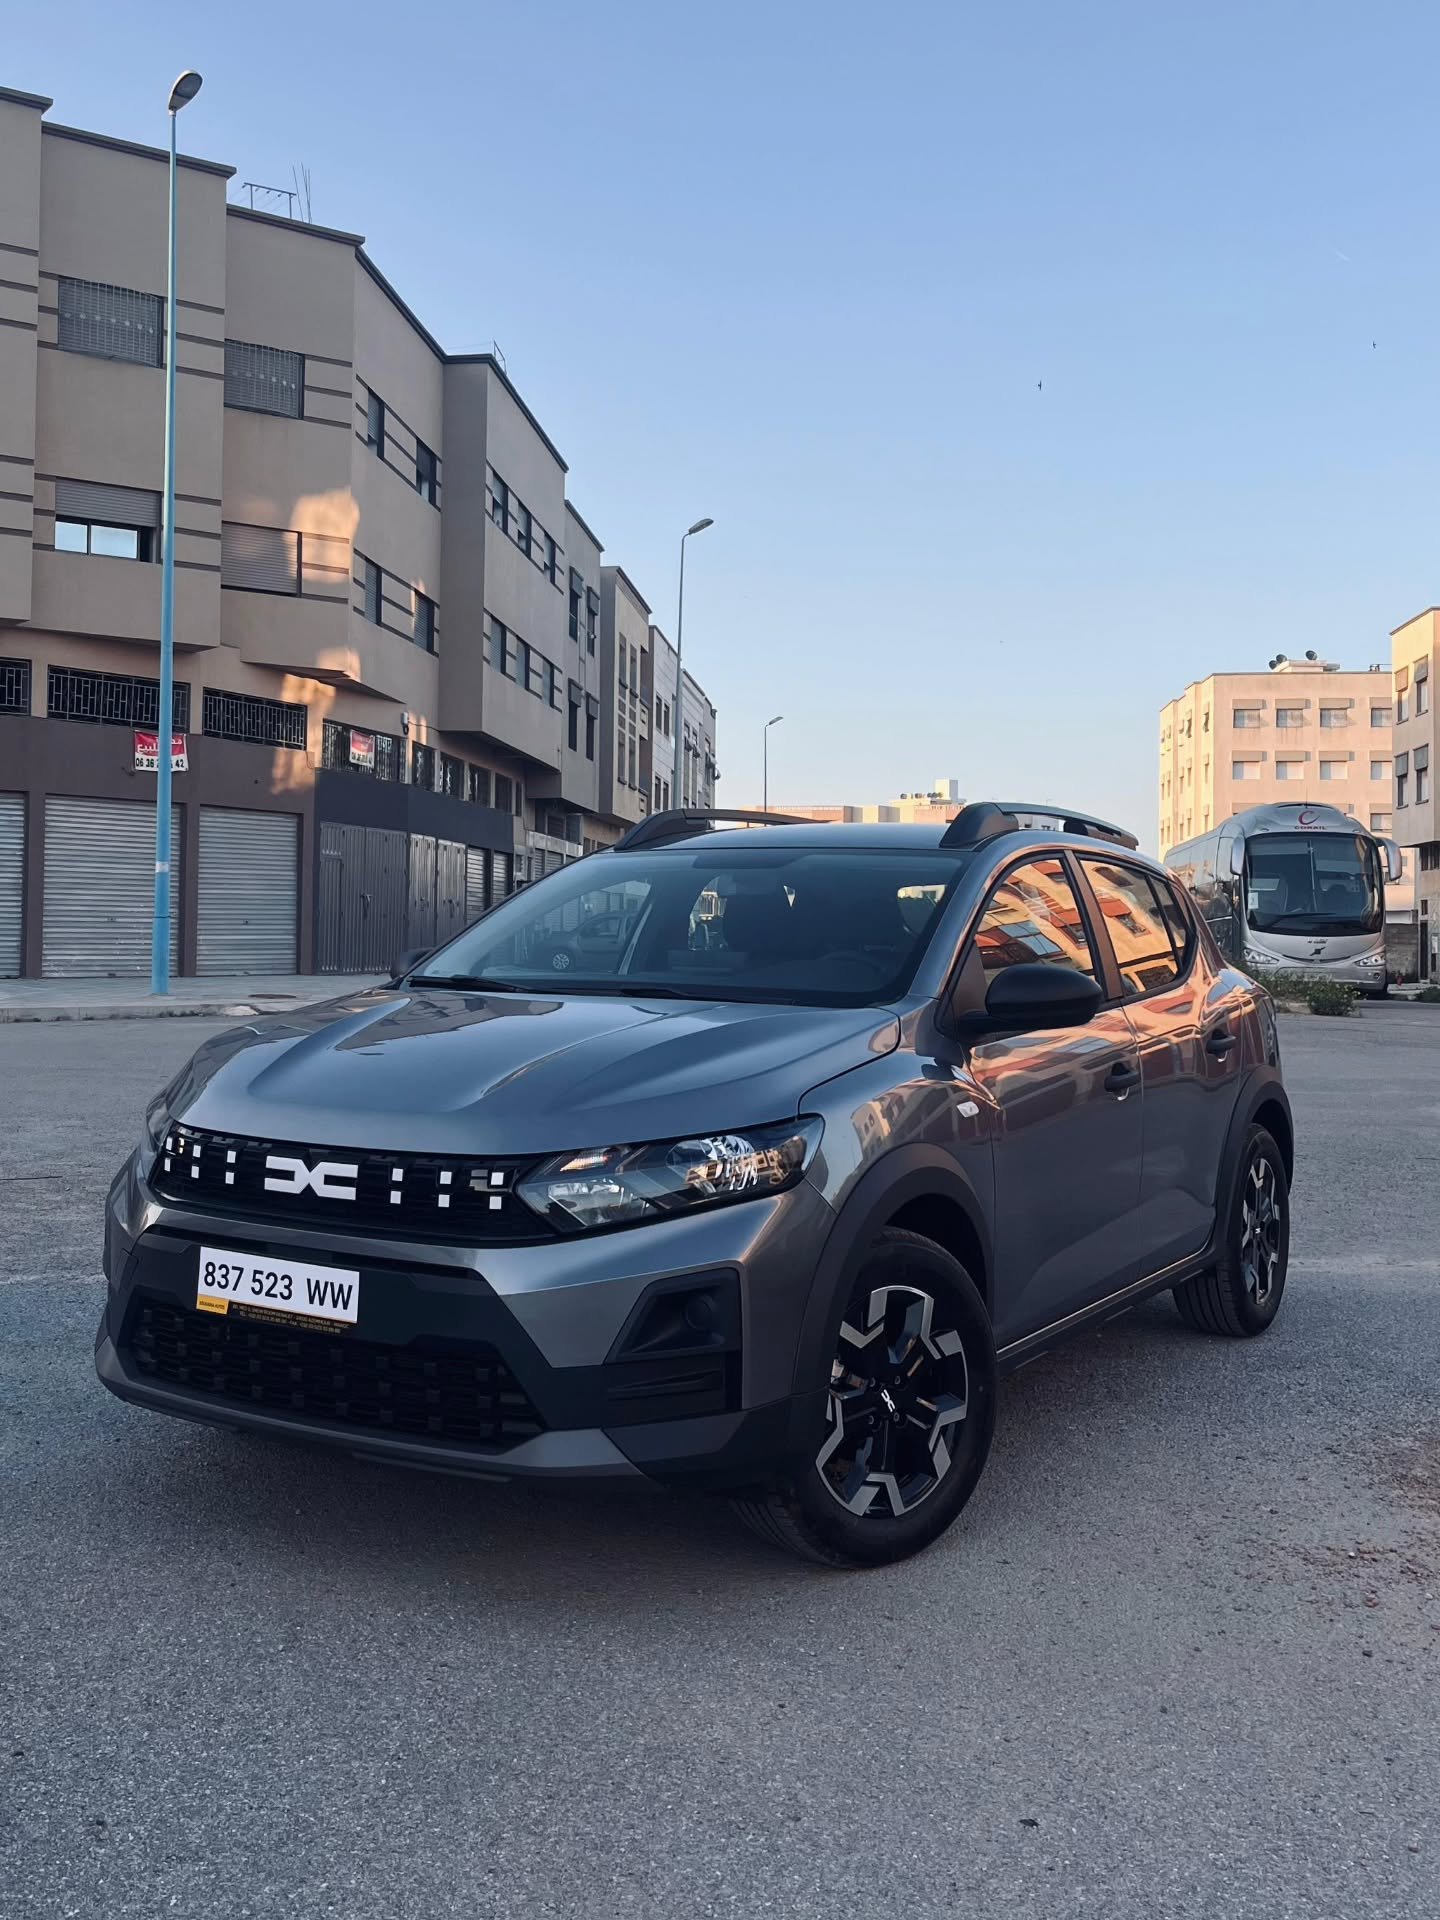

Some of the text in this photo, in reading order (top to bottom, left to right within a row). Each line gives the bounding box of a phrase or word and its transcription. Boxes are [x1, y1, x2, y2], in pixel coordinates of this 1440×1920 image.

[136, 757, 143, 767] 06
[175, 759, 184, 768] 42
[204, 1261, 353, 1310] 837 523 WW
